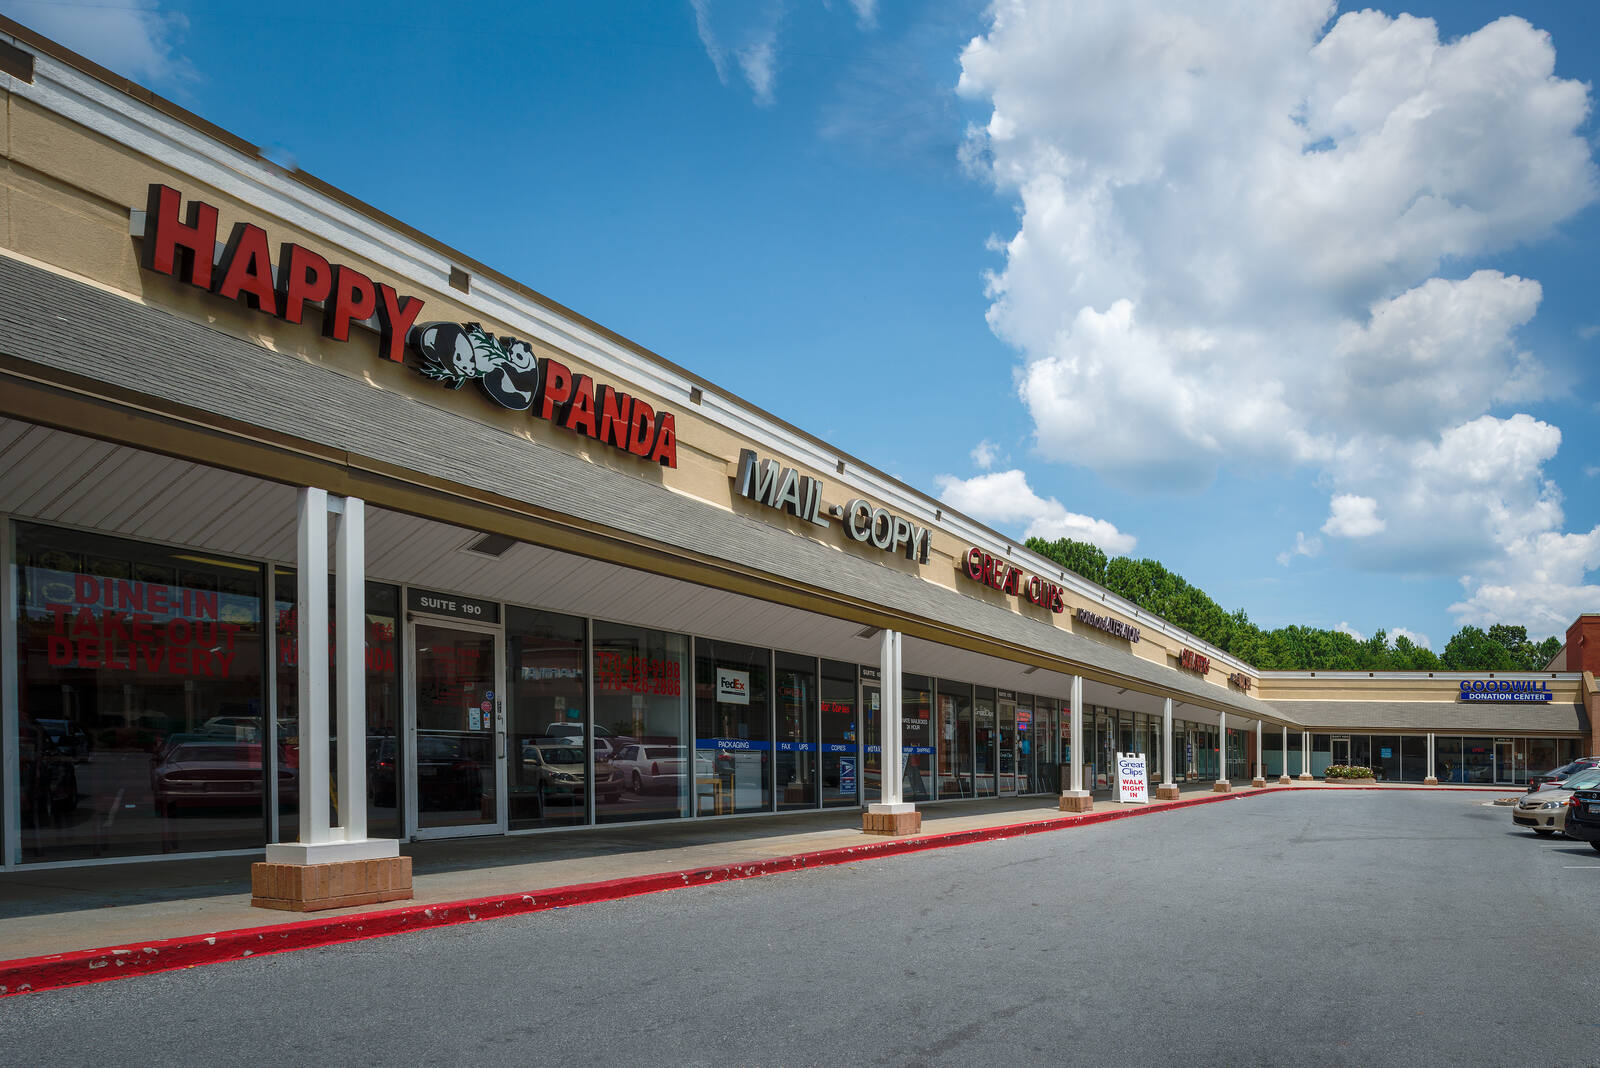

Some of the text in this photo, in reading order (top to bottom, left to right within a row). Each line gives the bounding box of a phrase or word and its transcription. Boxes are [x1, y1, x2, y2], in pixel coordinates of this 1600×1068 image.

[142, 184, 677, 468] HAPPY PANDA
[736, 448, 830, 528] MAIL
[963, 547, 1064, 614] GREAT CLIPS
[75, 574, 218, 619] DINE-IN
[420, 597, 481, 615] SUITE 190
[46, 603, 240, 650] TAKE-OUT
[48, 635, 235, 678] DELIVERY
[365, 648, 394, 672] NDA
[597, 653, 680, 679] 770-426-9188
[721, 677, 745, 690] FedEx
[1460, 680, 1552, 692] GOODWILL
[718, 740, 749, 749] PACKAGING
[1119, 760, 1144, 768] Great
[1122, 768, 1143, 777] Clips
